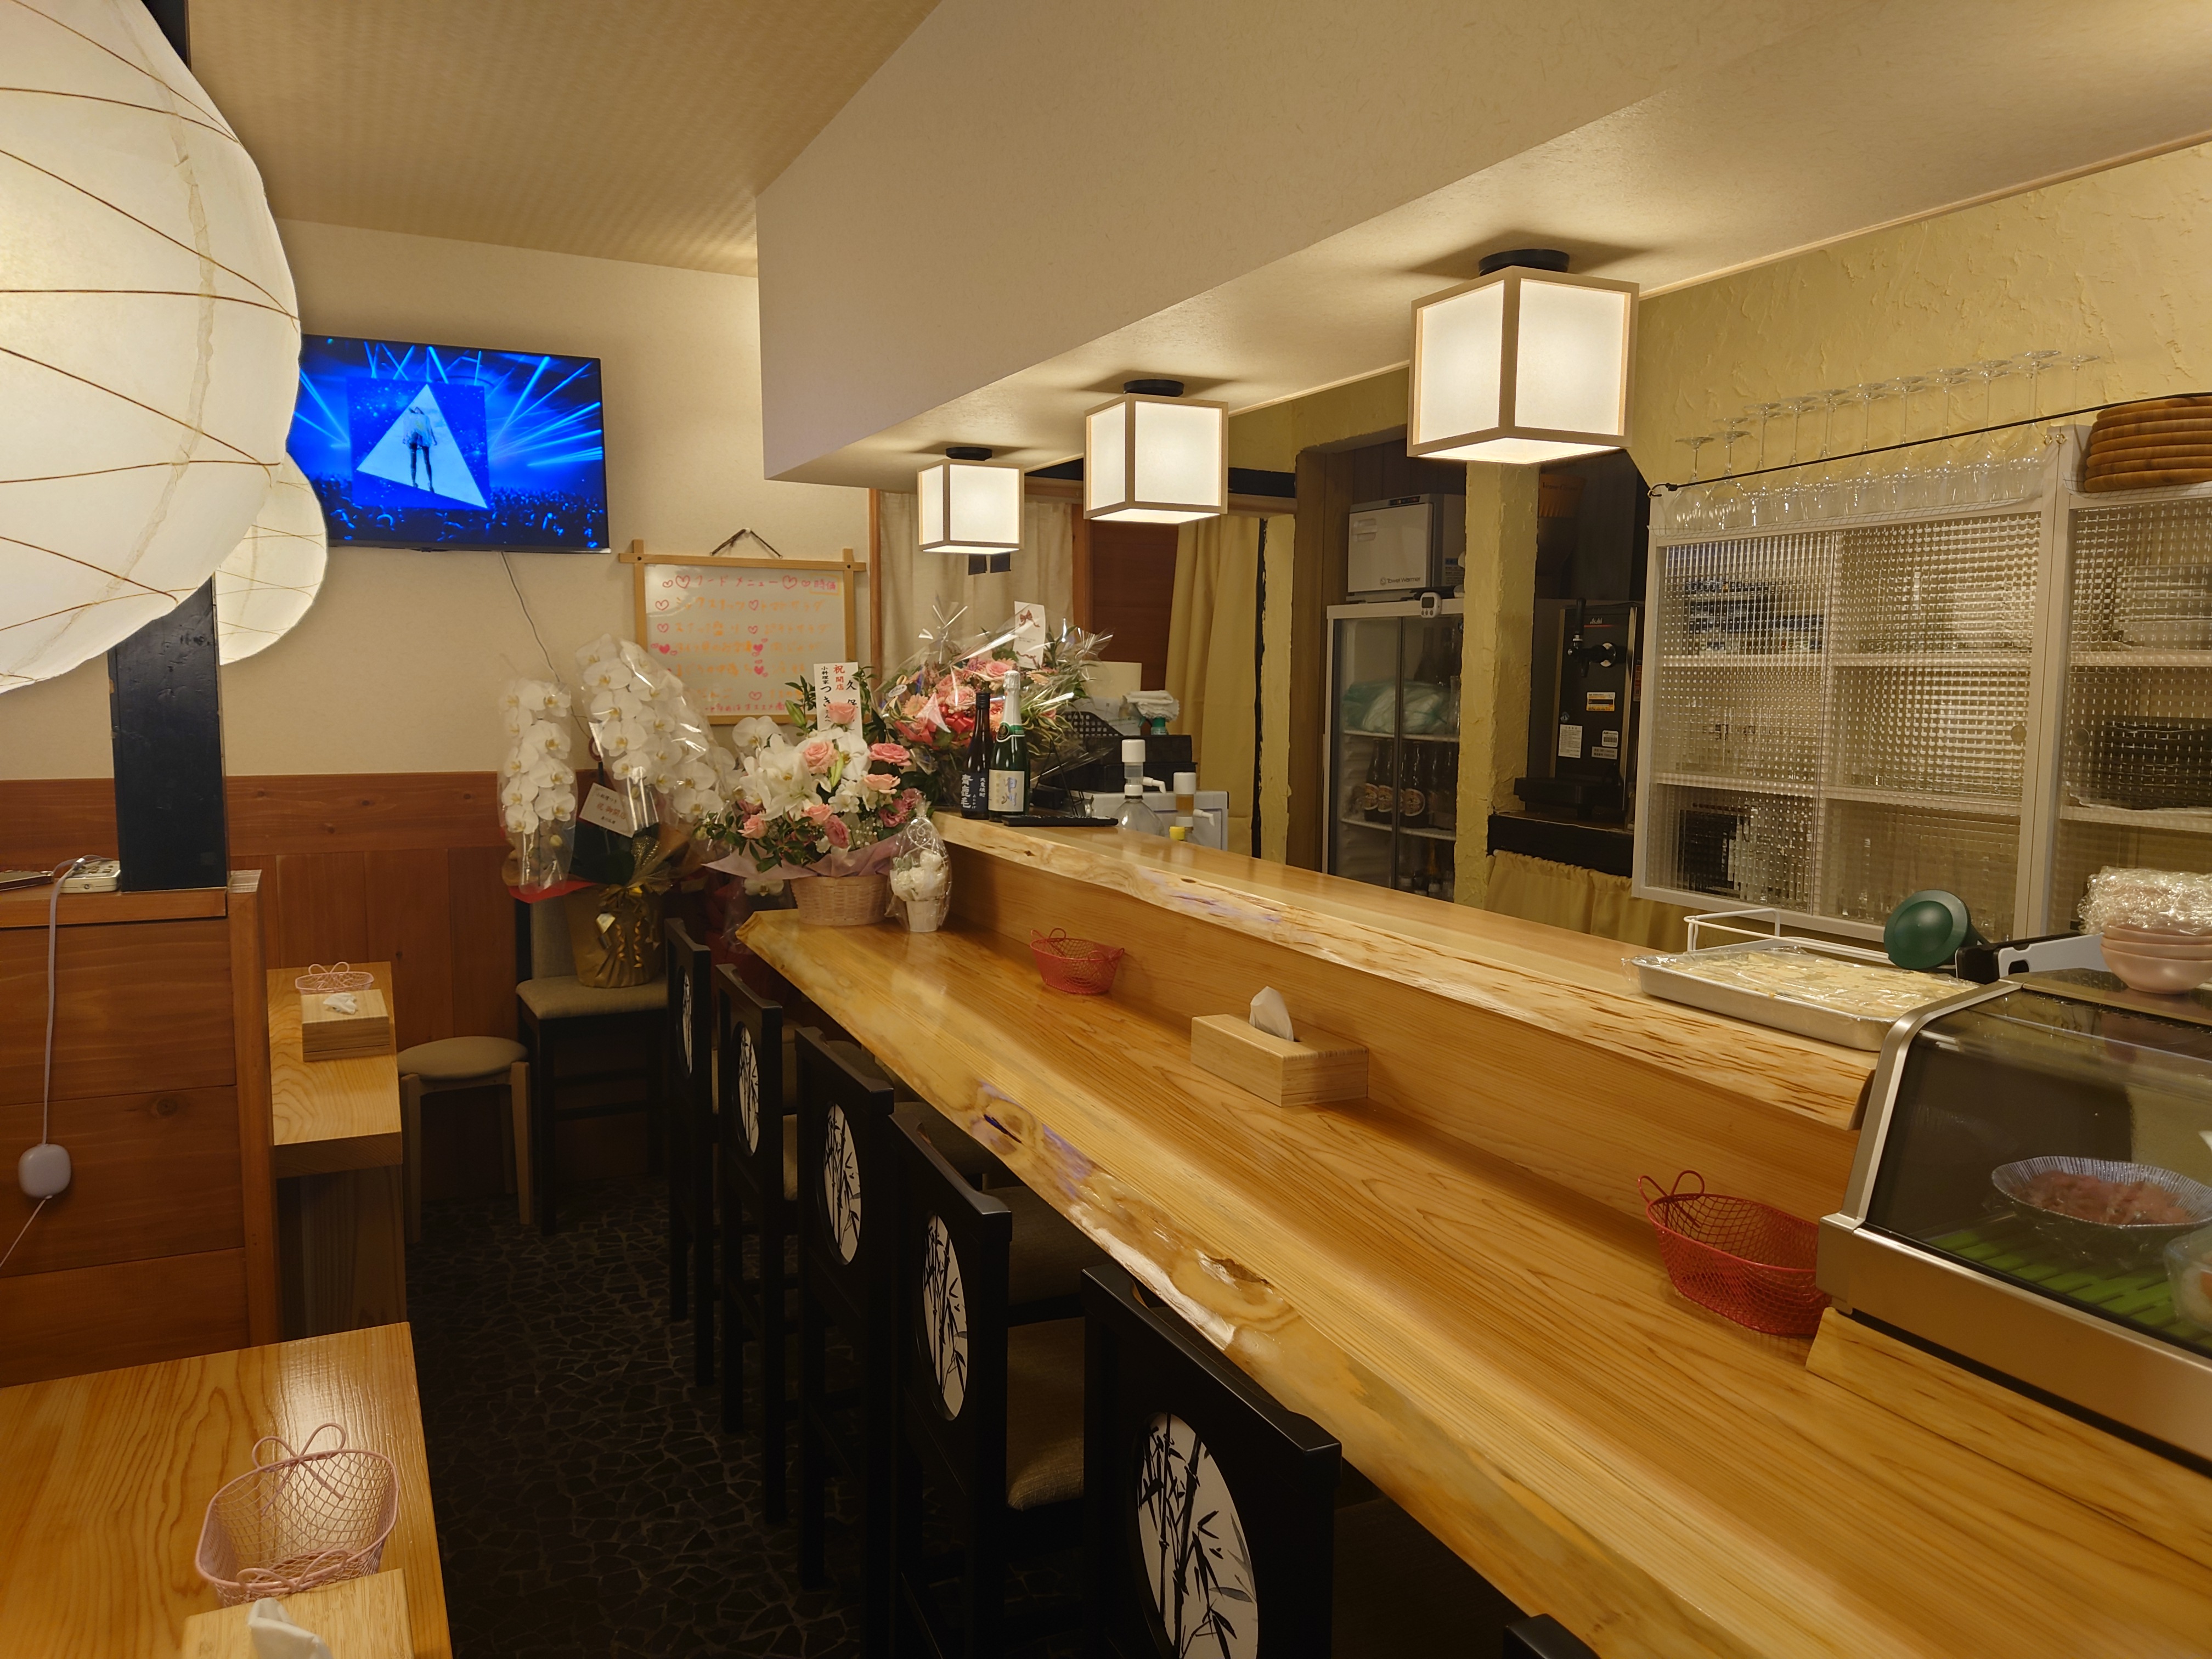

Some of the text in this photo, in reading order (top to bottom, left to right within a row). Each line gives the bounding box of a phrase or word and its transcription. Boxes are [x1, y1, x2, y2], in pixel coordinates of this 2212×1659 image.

[696, 575, 778, 588] フード メニュー
[814, 579, 836, 591] 時価
